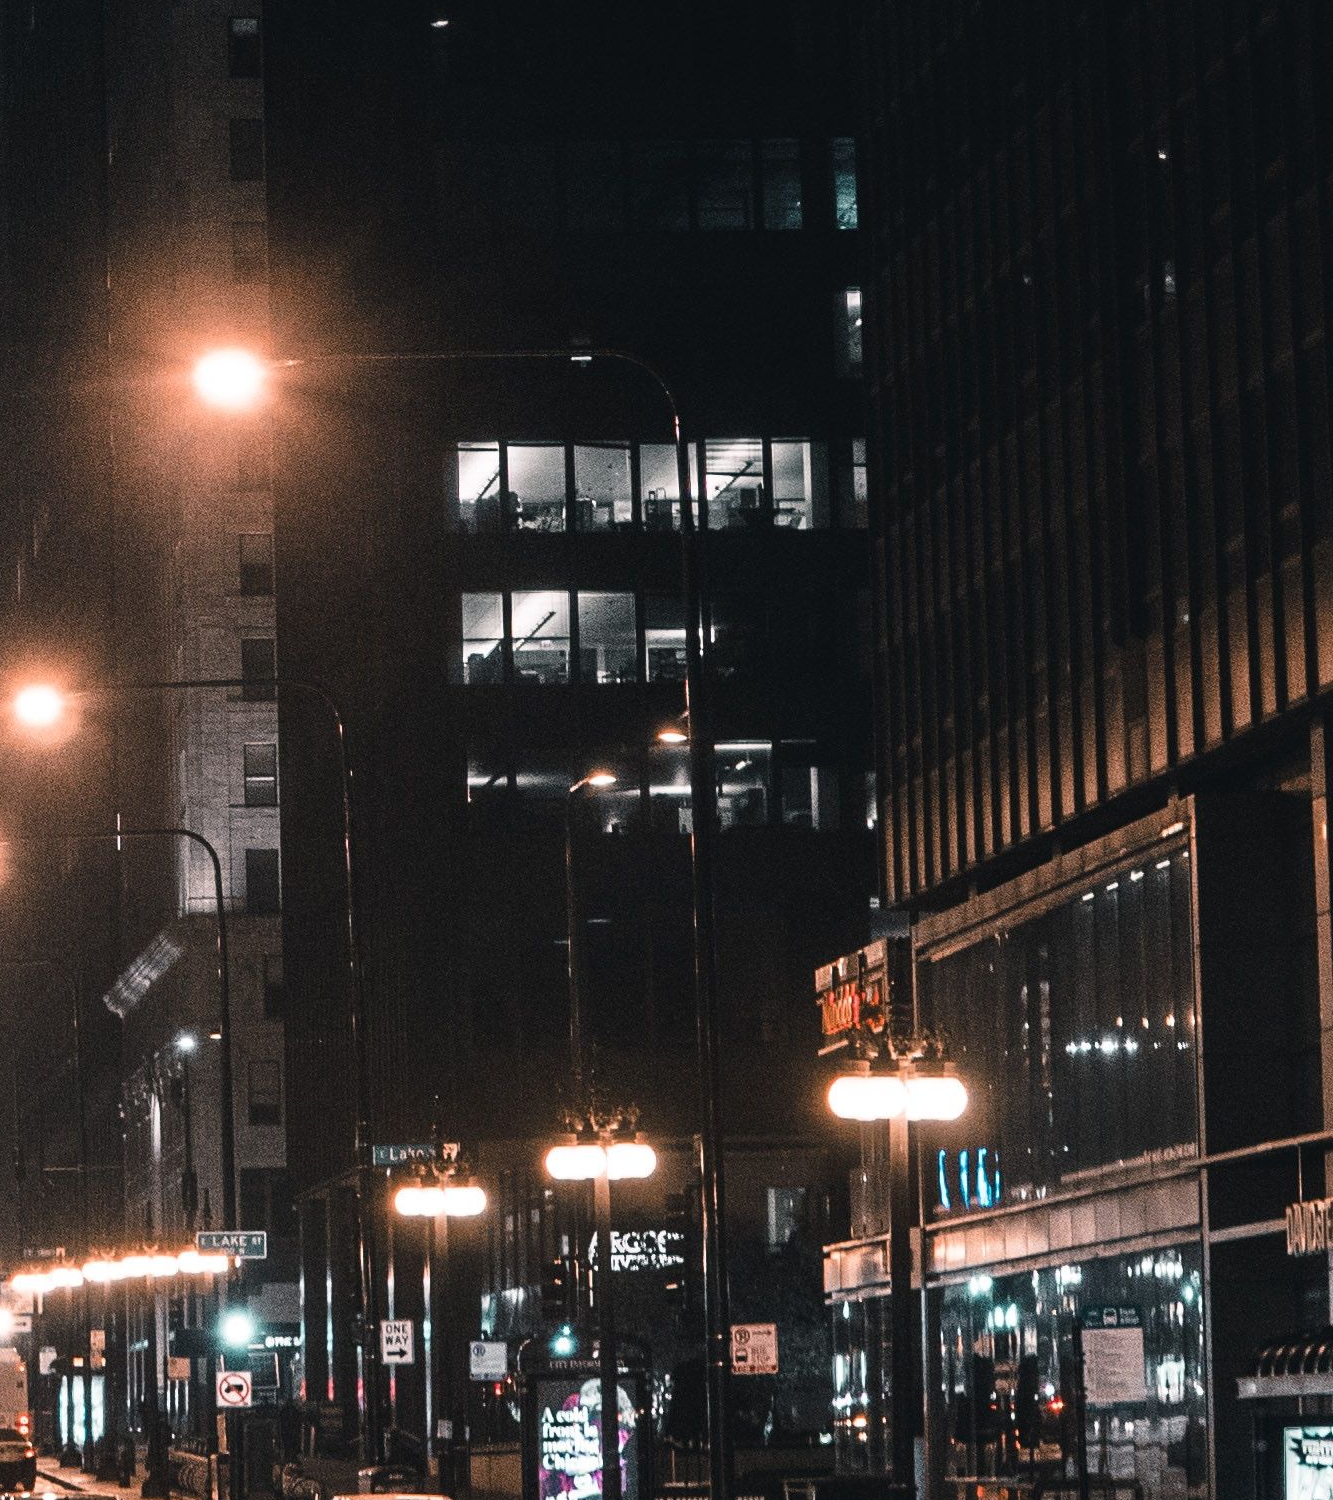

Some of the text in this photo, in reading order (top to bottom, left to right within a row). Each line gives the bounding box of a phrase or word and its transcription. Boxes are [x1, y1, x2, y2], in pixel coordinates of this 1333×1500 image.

[212, 1235, 247, 1247] LAKE
[385, 1323, 407, 1335] ONE
[385, 1335, 409, 1346] WAY
[542, 1406, 589, 1423] A cold
